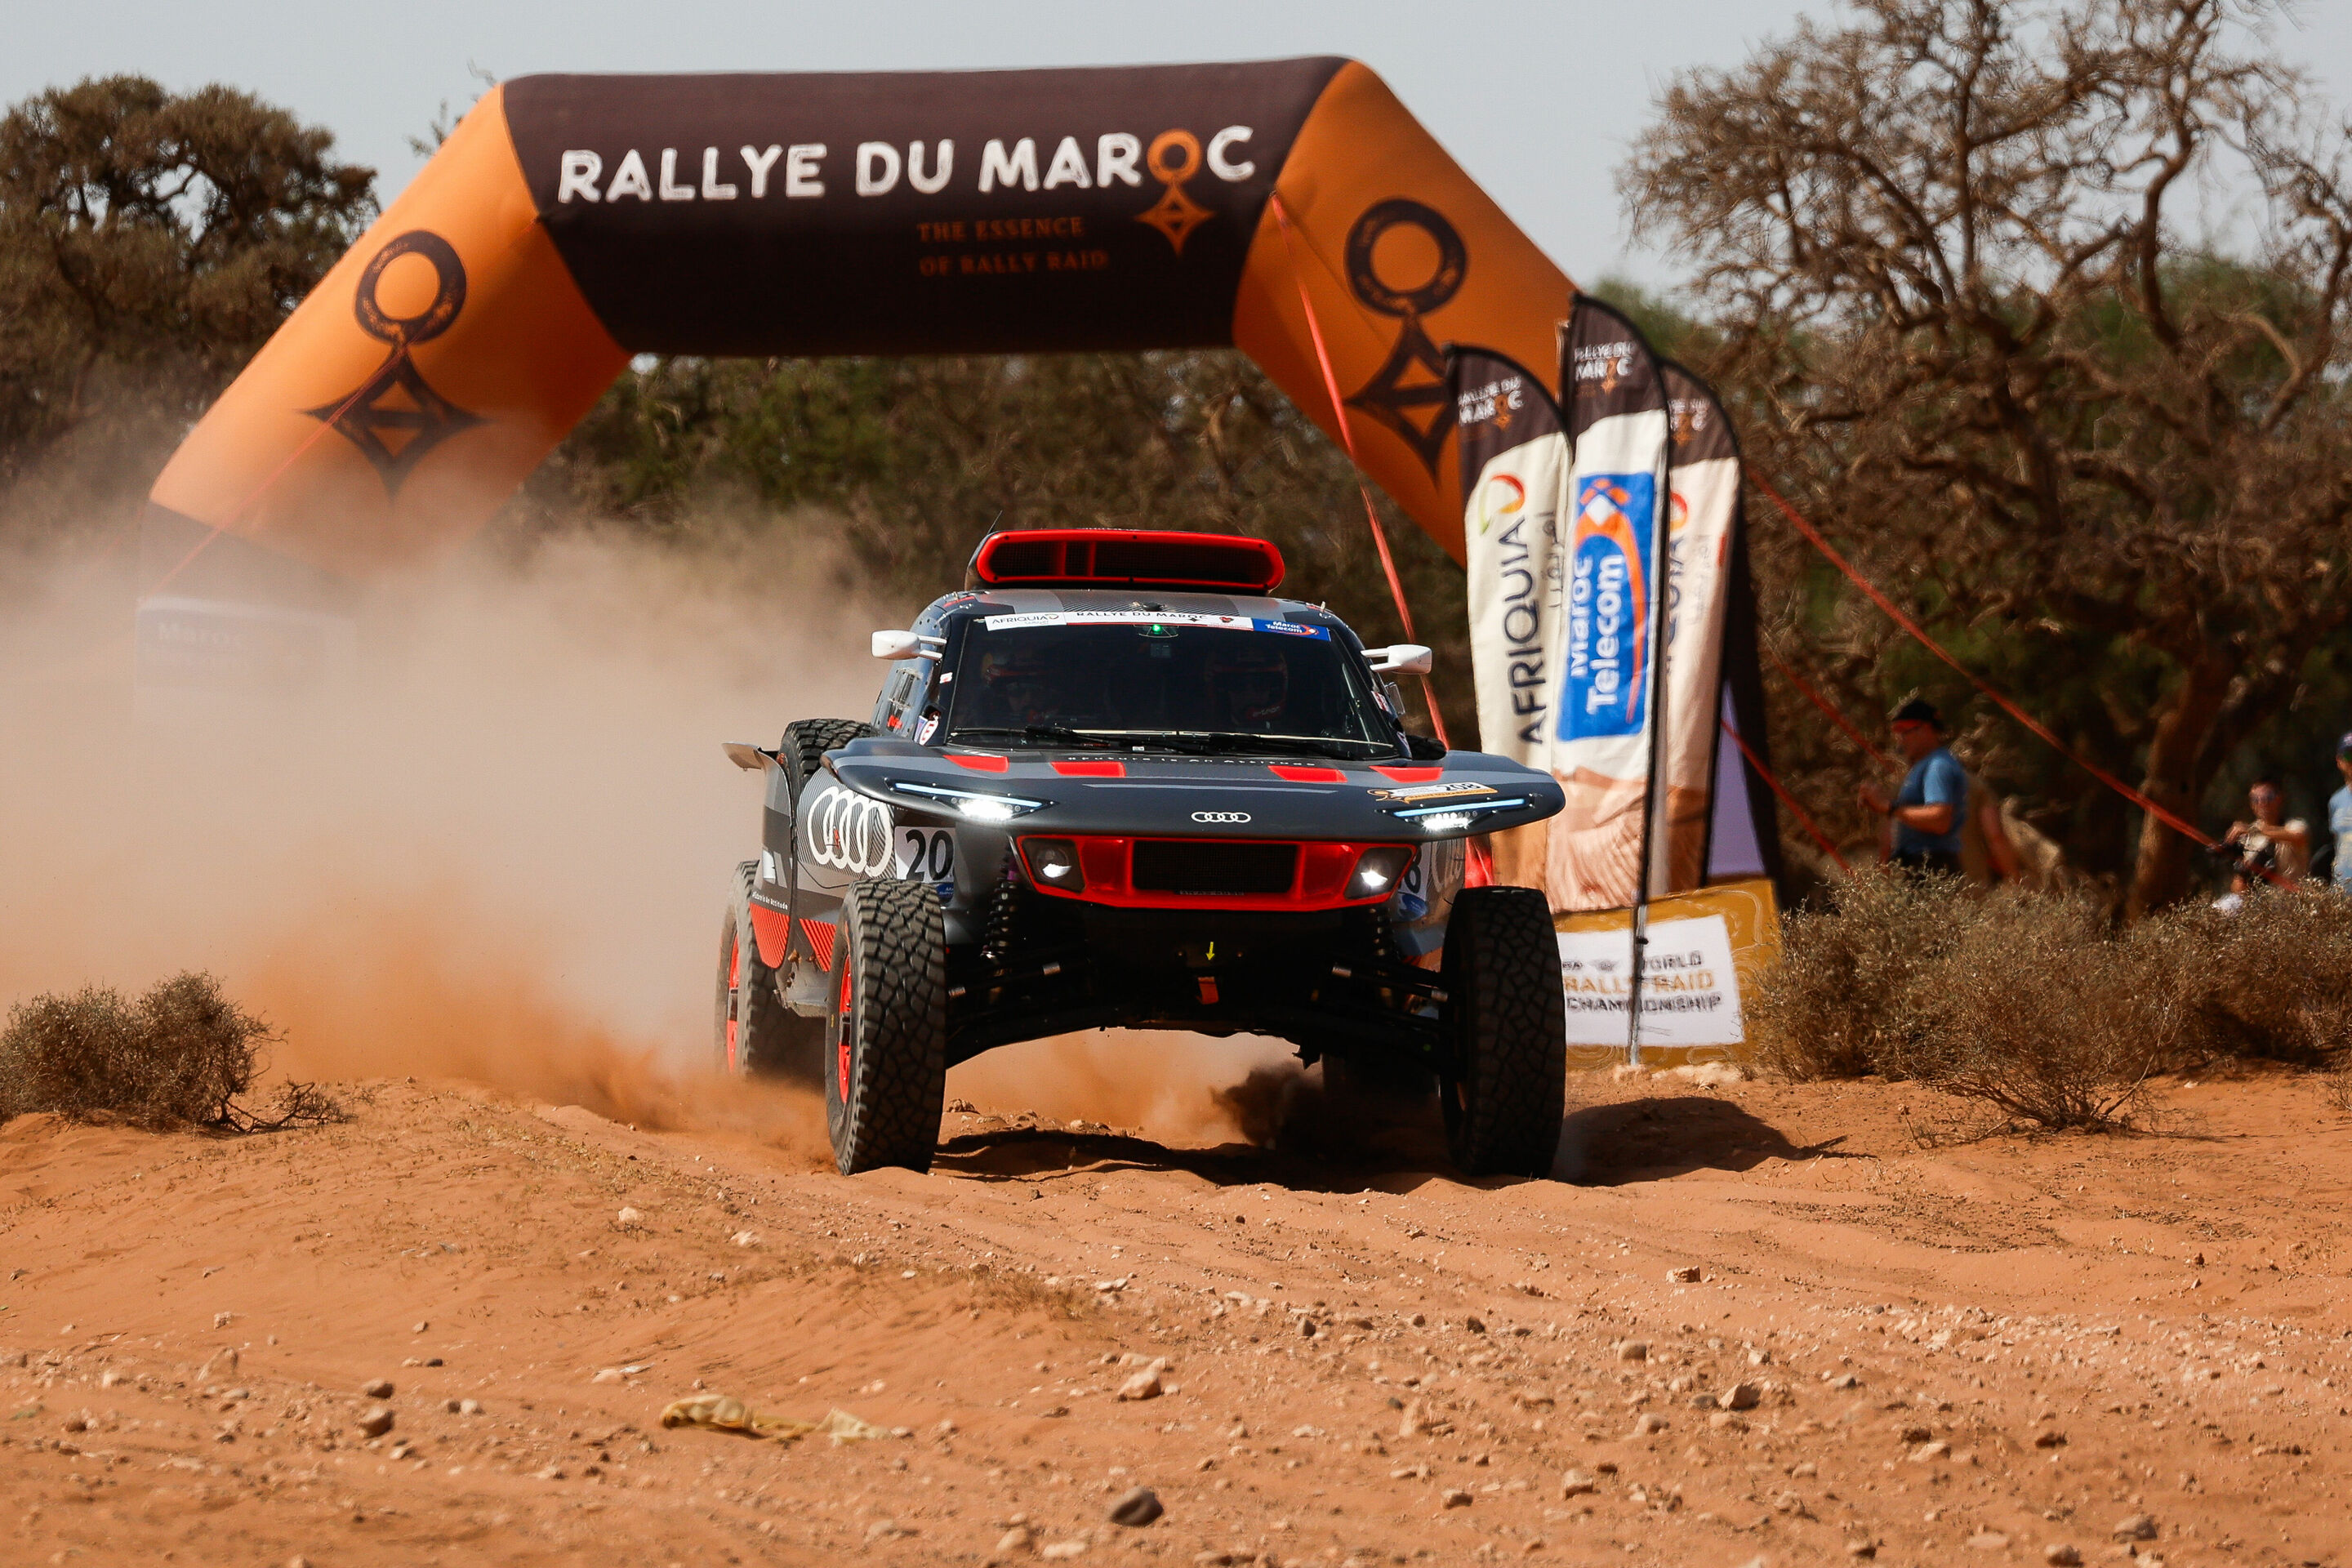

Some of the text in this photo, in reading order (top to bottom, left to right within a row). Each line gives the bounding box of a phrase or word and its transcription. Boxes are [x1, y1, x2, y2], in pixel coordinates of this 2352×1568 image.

[558, 125, 1255, 203] RALLYE DU MAROC
[916, 216, 1085, 242] THE ESSENCE
[920, 249, 1110, 276] OF RALLY RAID
[992, 615, 1049, 624] AFRIQUIA
[1264, 623, 1303, 634] Telecom
[1272, 621, 1301, 630] Maroc
[1498, 514, 1547, 745] AFRIQUIA
[1570, 555, 1594, 679] Maroc
[1585, 554, 1625, 716] Telecom
[1437, 782, 1481, 791] 208
[1642, 950, 1703, 970] ORLD
